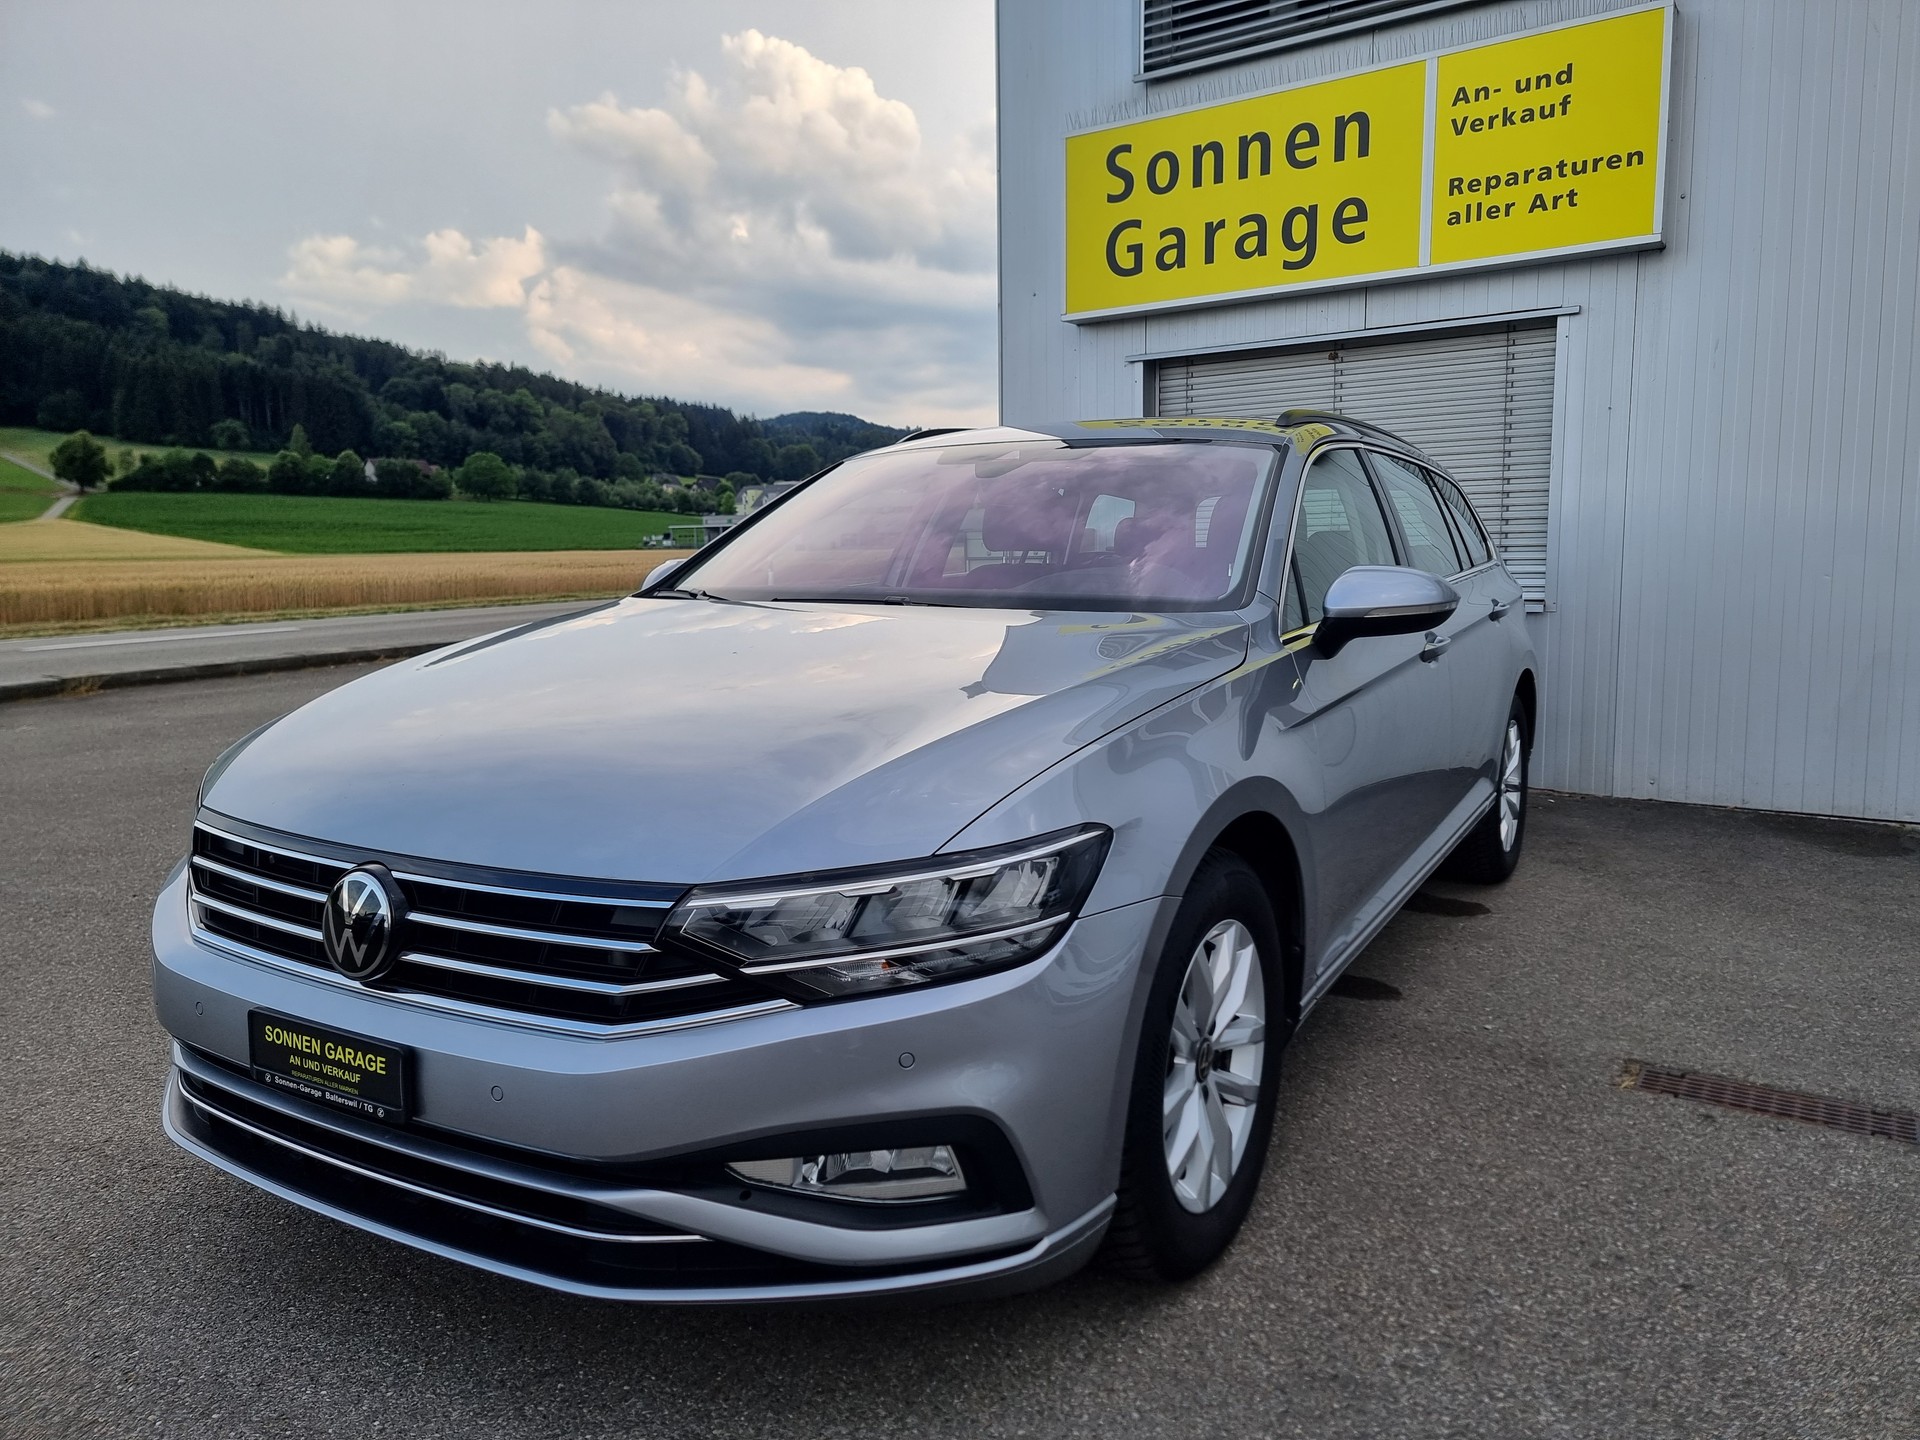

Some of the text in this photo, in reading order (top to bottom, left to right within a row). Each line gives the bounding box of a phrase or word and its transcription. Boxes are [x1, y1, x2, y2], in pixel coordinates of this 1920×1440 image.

[1450, 62, 1573, 108] An- und
[1450, 93, 1572, 137] Verkauf
[1105, 110, 1371, 204] Sonnen
[1448, 149, 1644, 197] Reparaturen
[1446, 188, 1579, 226] aller Art
[1105, 197, 1369, 278] Garage
[264, 1025, 387, 1075] SONNEN GARAGE
[289, 1054, 361, 1084] AN UND VERKAUF
[274, 1075, 322, 1098] Sonnen-Garage
[363, 1103, 374, 1113] TG
